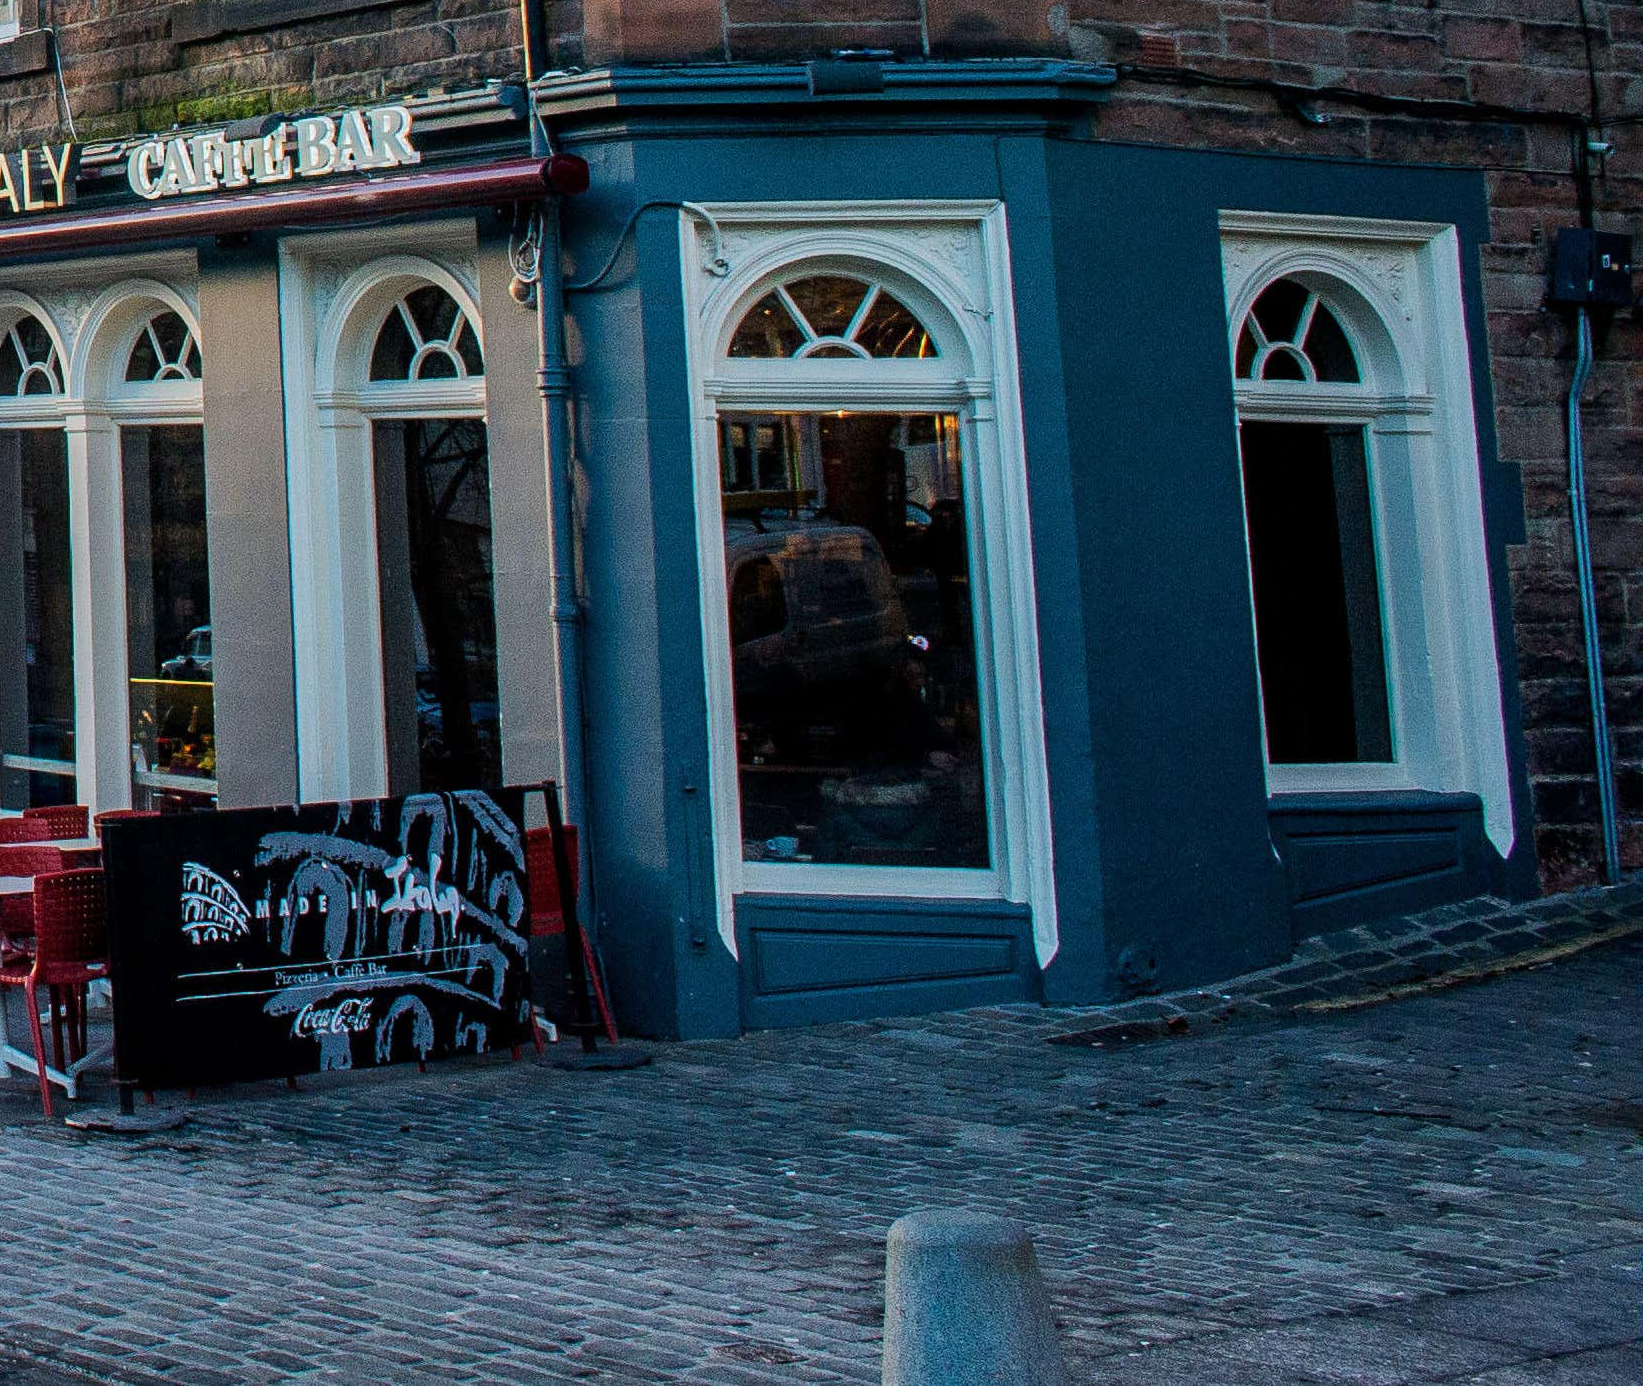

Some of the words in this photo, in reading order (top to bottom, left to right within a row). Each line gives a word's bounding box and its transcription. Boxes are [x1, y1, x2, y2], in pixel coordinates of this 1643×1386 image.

[295, 106, 421, 176] BAR
[255, 895, 327, 918] MADE
[351, 889, 377, 910] IN
[380, 853, 460, 938] Italy
[275, 970, 318, 986] Pizzeria
[368, 962, 387, 976] Bar
[293, 998, 374, 1037] Coca-Cola
